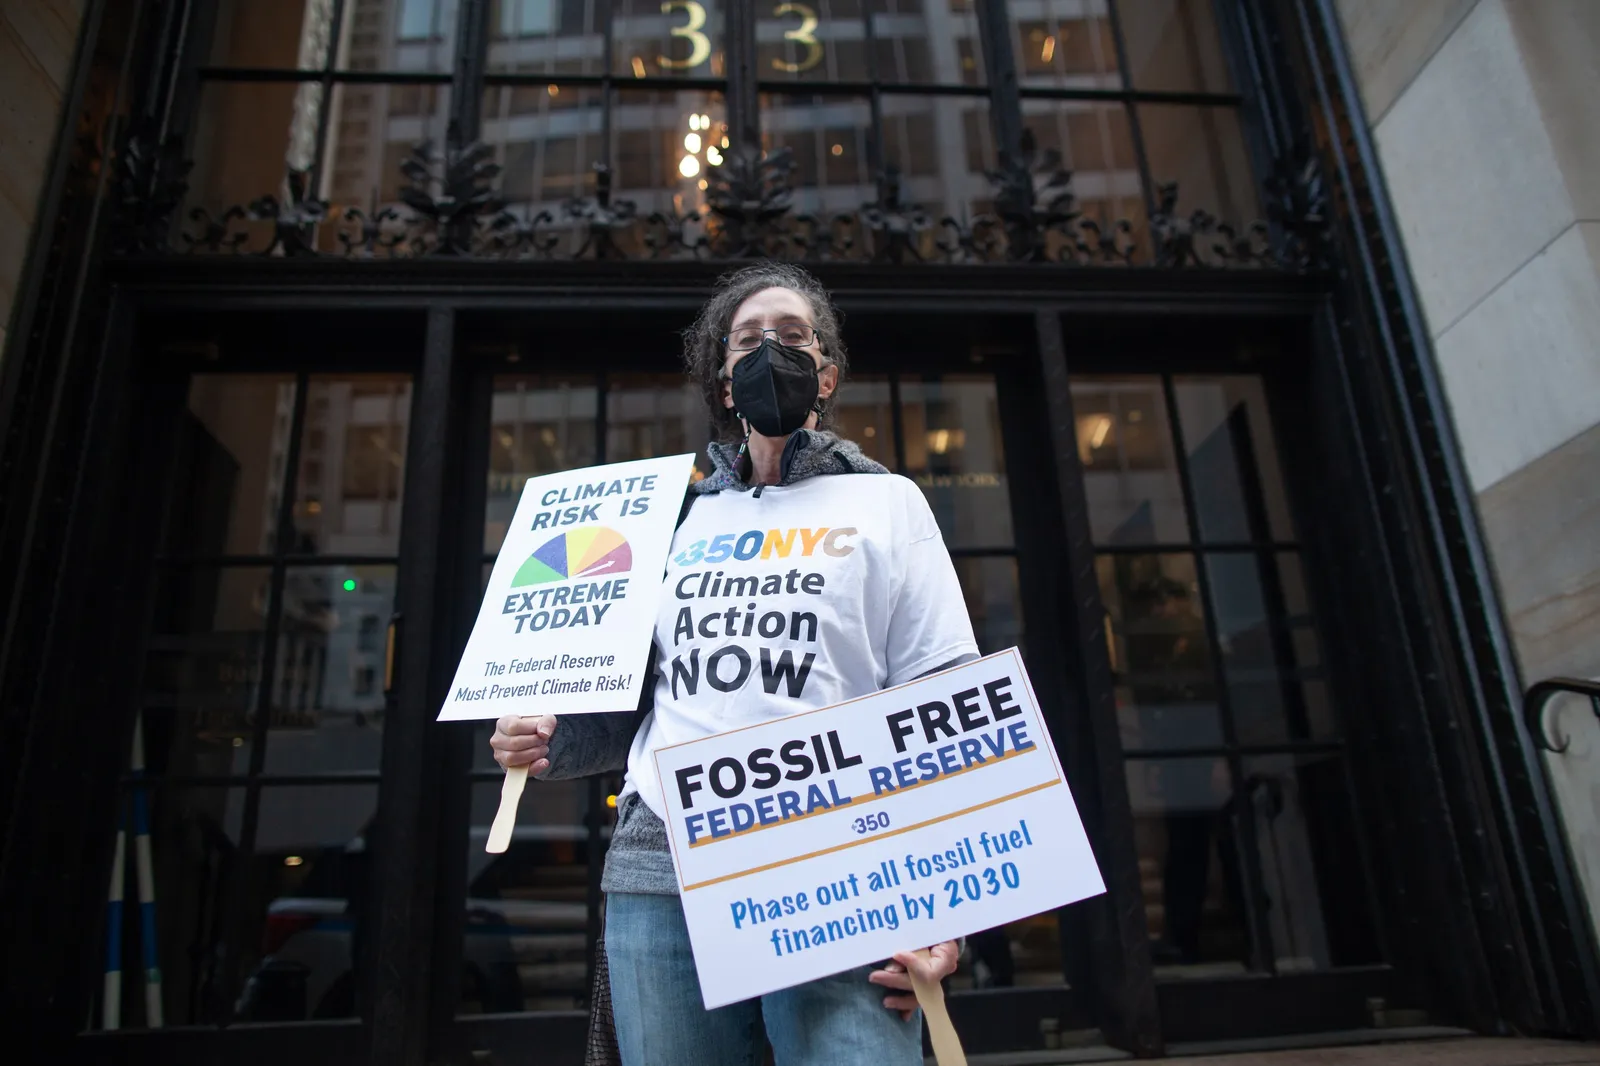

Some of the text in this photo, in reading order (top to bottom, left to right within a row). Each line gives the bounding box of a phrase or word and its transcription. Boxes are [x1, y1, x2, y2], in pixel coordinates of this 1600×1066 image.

[540, 474, 658, 507] CLIMATE
[530, 496, 650, 531] RISK IS
[673, 526, 858, 567] 350NYC
[502, 578, 629, 615] EXTREME
[675, 568, 825, 600] Climate
[514, 603, 612, 634] TODAY
[674, 602, 818, 647] Action
[484, 653, 615, 677] The Federal Reserve
[671, 644, 817, 701] NOW
[454, 673, 633, 702] Must Prevent Climate Risk!
[674, 675, 1023, 810] FOSSIL FREE
[684, 720, 1035, 845] FEDERAL RESERVE
[854, 811, 890, 834] 350
[730, 819, 1033, 929] Phase out all fossil fuel
[770, 861, 1020, 957] financing by 2030
